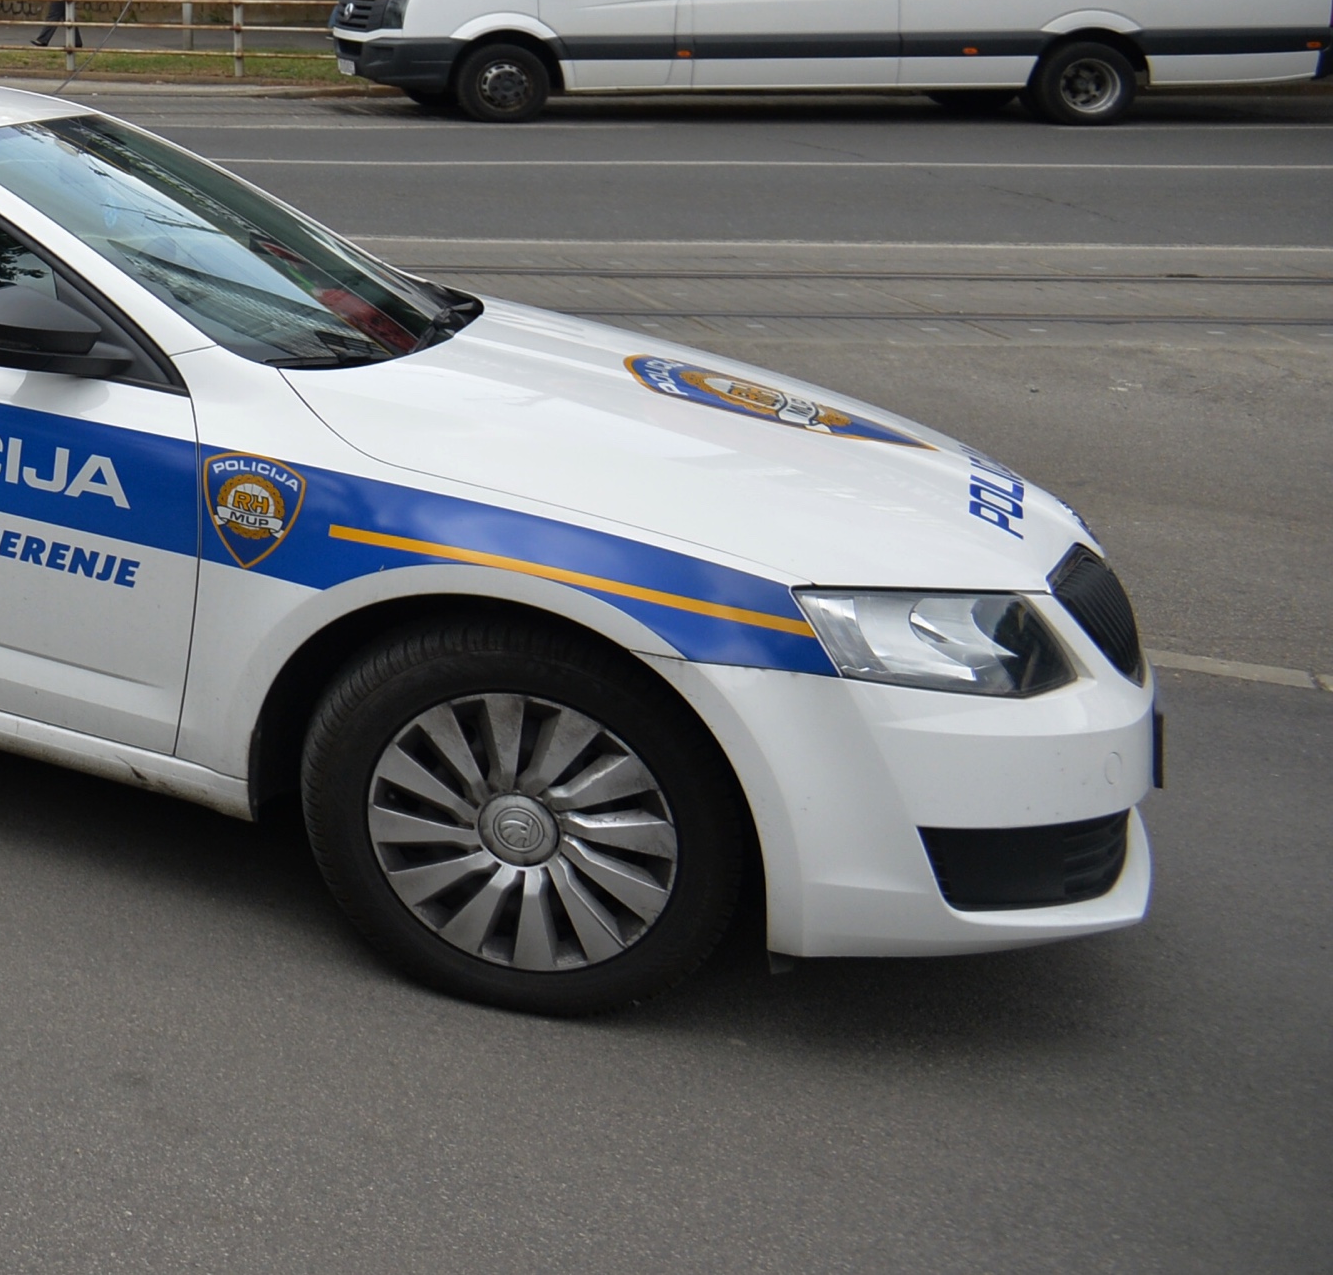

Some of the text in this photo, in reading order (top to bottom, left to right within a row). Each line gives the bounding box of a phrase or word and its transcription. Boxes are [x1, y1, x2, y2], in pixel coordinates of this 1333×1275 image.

[212, 459, 300, 492] POLICIJA
[232, 490, 270, 515] RH
[229, 511, 269, 527] MUP
